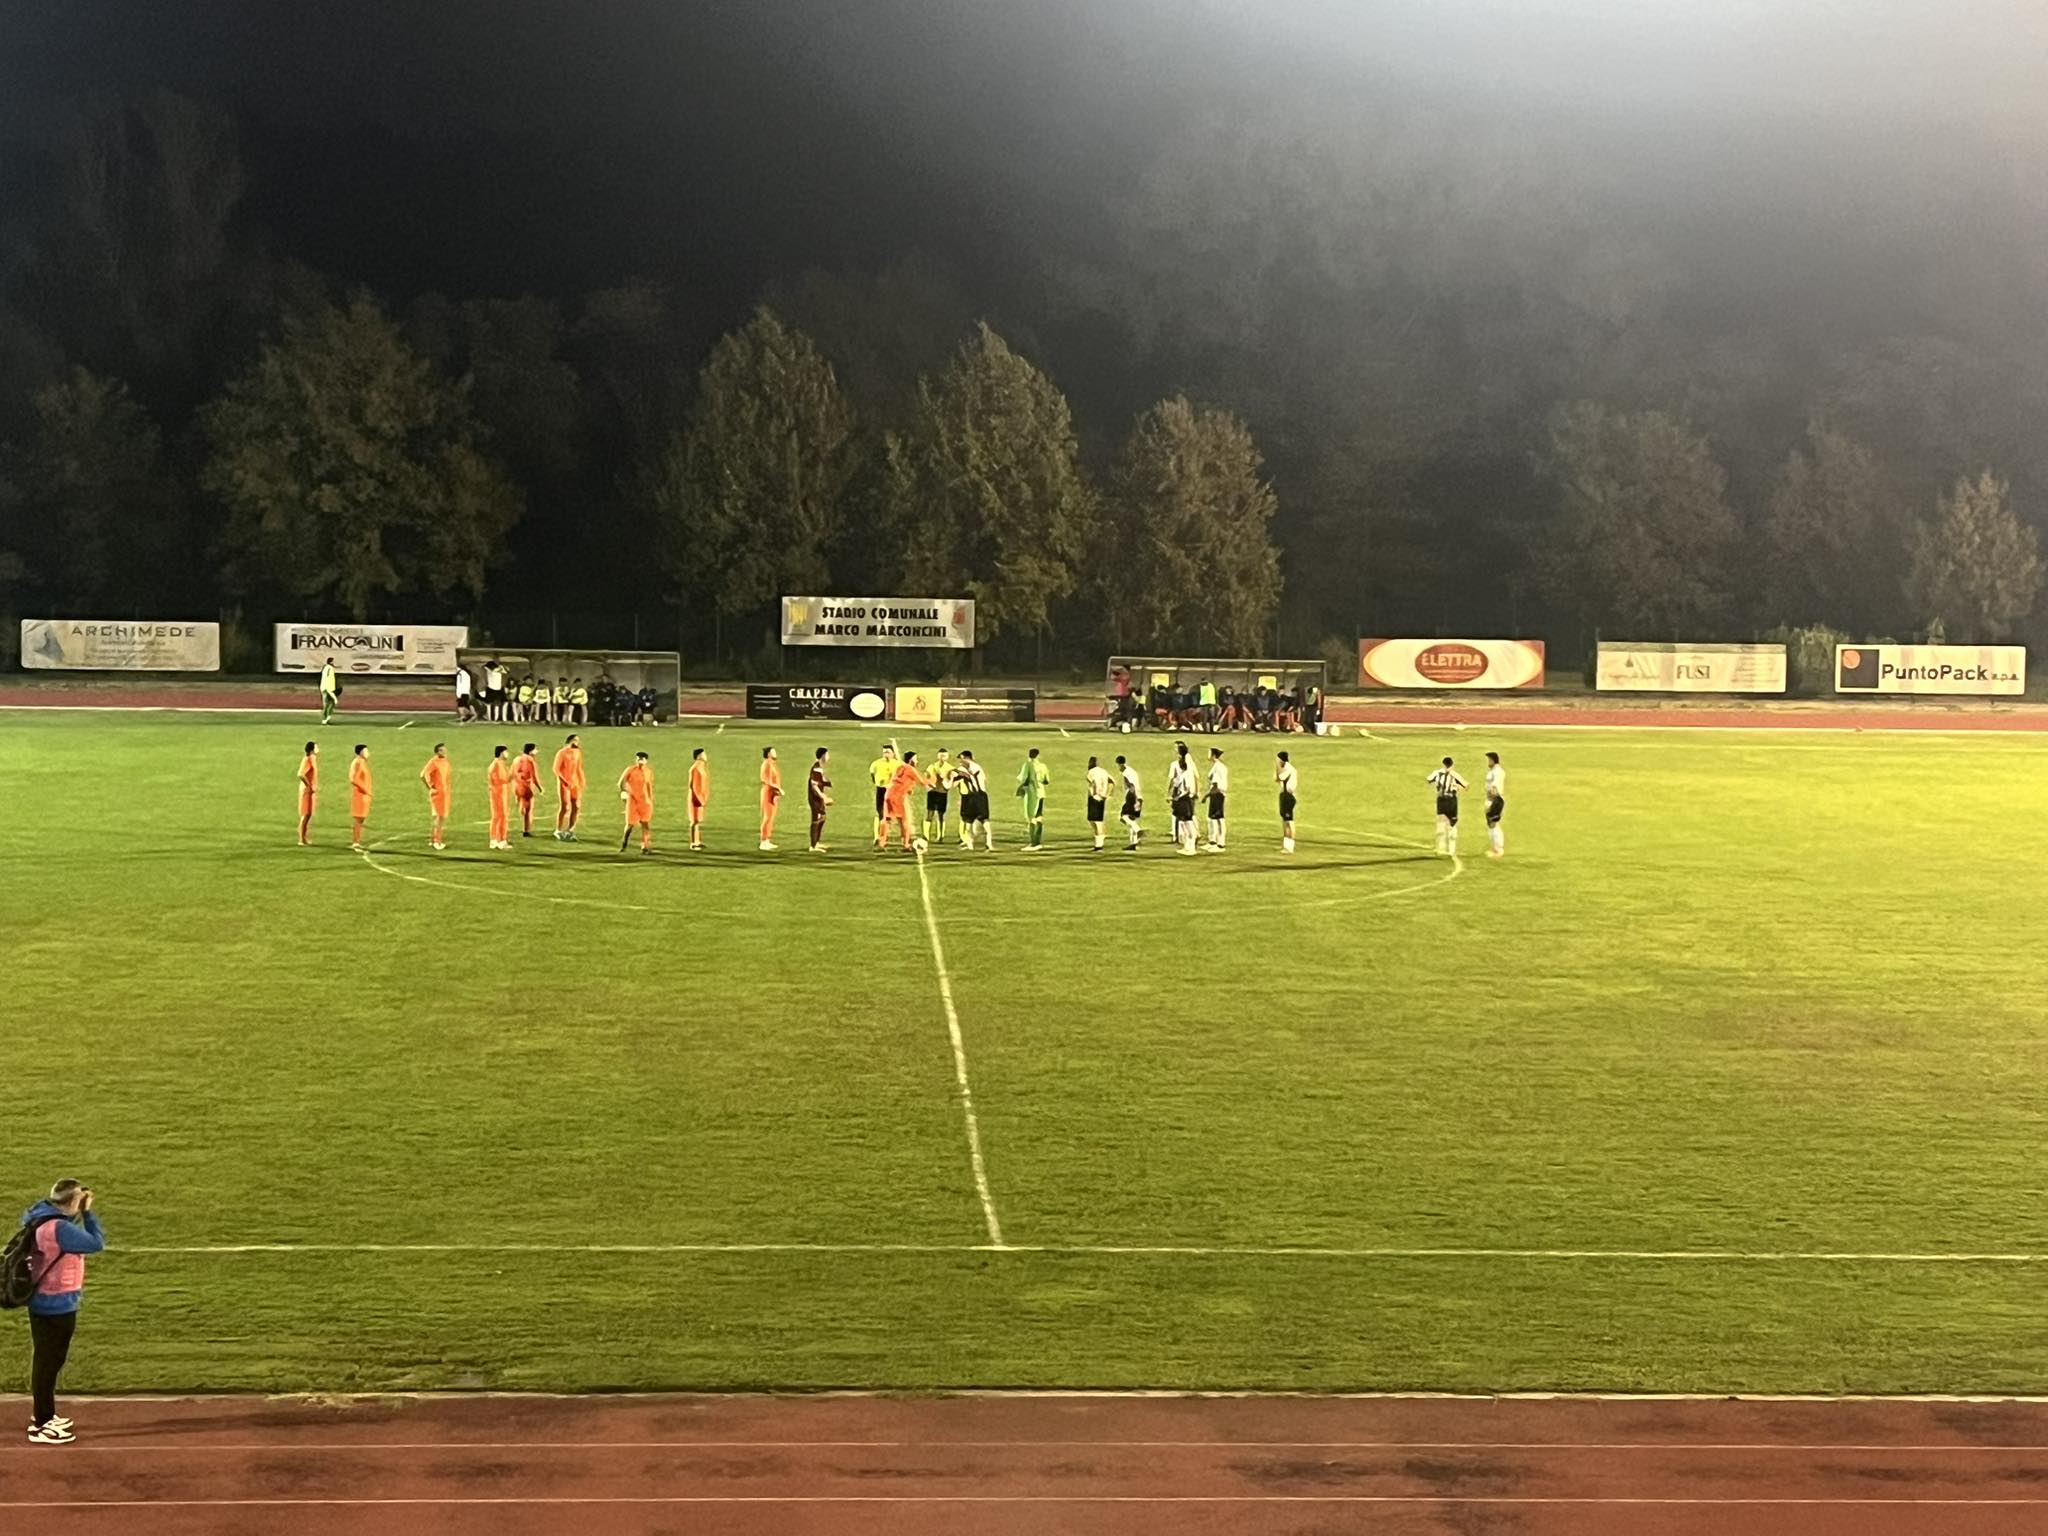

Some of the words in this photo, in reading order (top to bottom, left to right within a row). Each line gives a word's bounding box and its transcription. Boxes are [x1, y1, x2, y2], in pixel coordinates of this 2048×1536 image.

[71, 625, 196, 638] ARCHIMEDE
[814, 624, 860, 636] MARCO
[1421, 653, 1482, 666] ELETTRA
[1676, 665, 1711, 680] FUSI
[1881, 664, 1988, 681] PuntoPack
